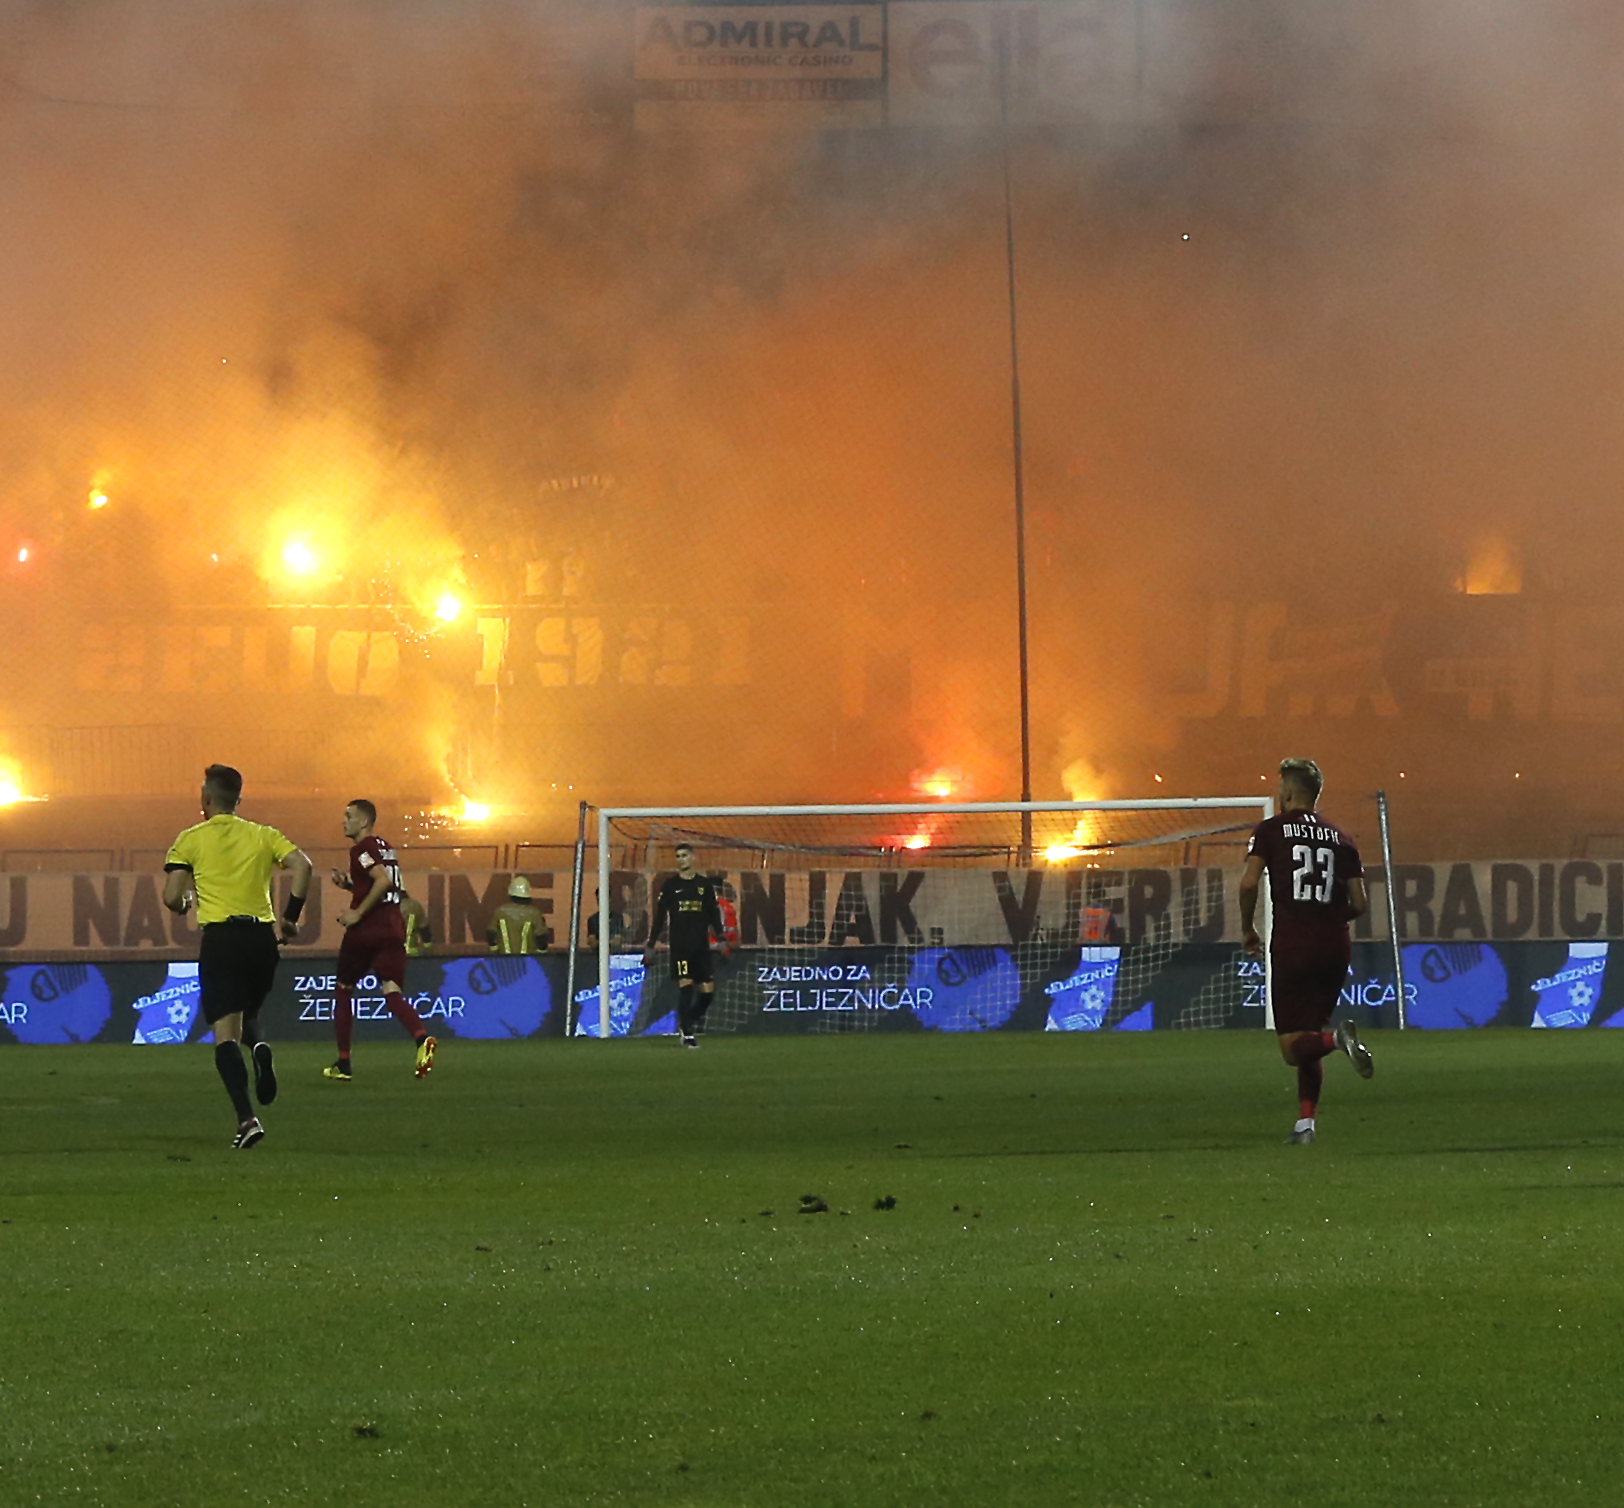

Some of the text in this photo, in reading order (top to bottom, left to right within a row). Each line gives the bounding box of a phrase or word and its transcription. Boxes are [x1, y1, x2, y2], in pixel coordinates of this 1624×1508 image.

[643, 15, 883, 52] ADMIRAL
[787, 54, 854, 67] CASINO
[1292, 844, 1335, 905] 23
[427, 872, 554, 947] IME
[677, 960, 689, 976] 13
[757, 964, 871, 983] ZAJEDNO ZA
[761, 984, 934, 1013] ŽELJEZNIČAR
